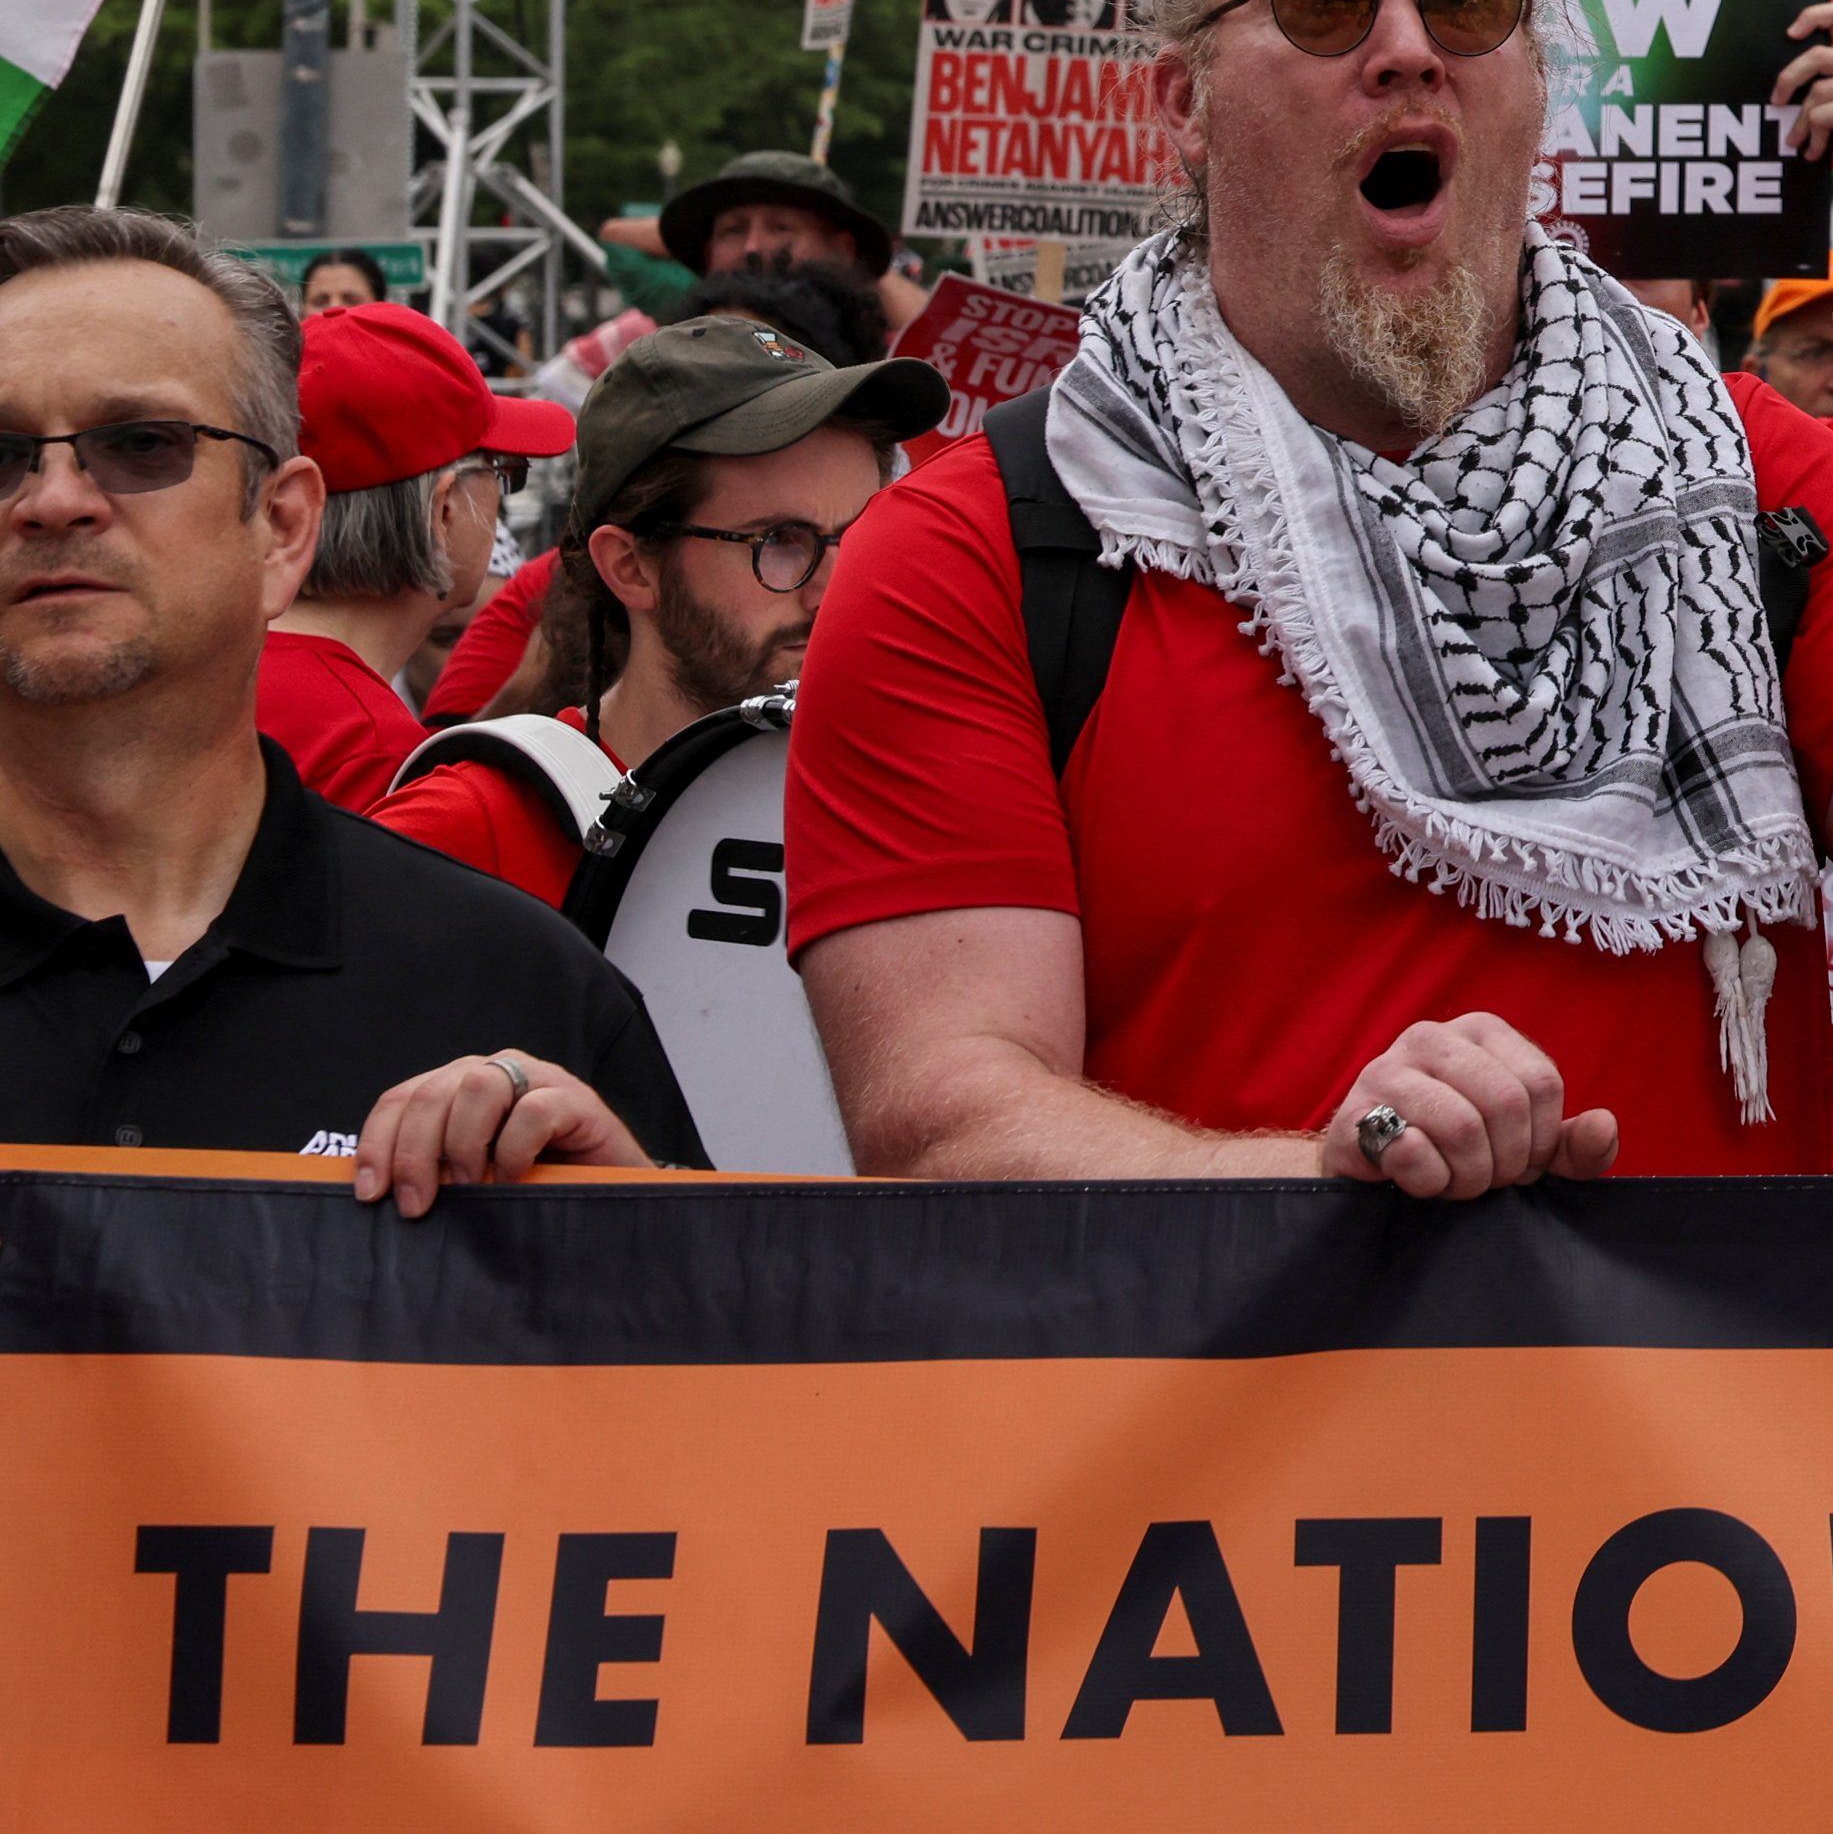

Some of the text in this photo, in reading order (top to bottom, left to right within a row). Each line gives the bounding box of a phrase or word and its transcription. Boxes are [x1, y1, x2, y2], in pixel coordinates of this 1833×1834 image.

[934, 28, 1013, 51] WAR
[1601, 65, 1634, 97] A
[1541, 103, 1803, 158] ANENT
[961, 294, 1077, 334] STOP
[133, 1524, 678, 1748] THE
